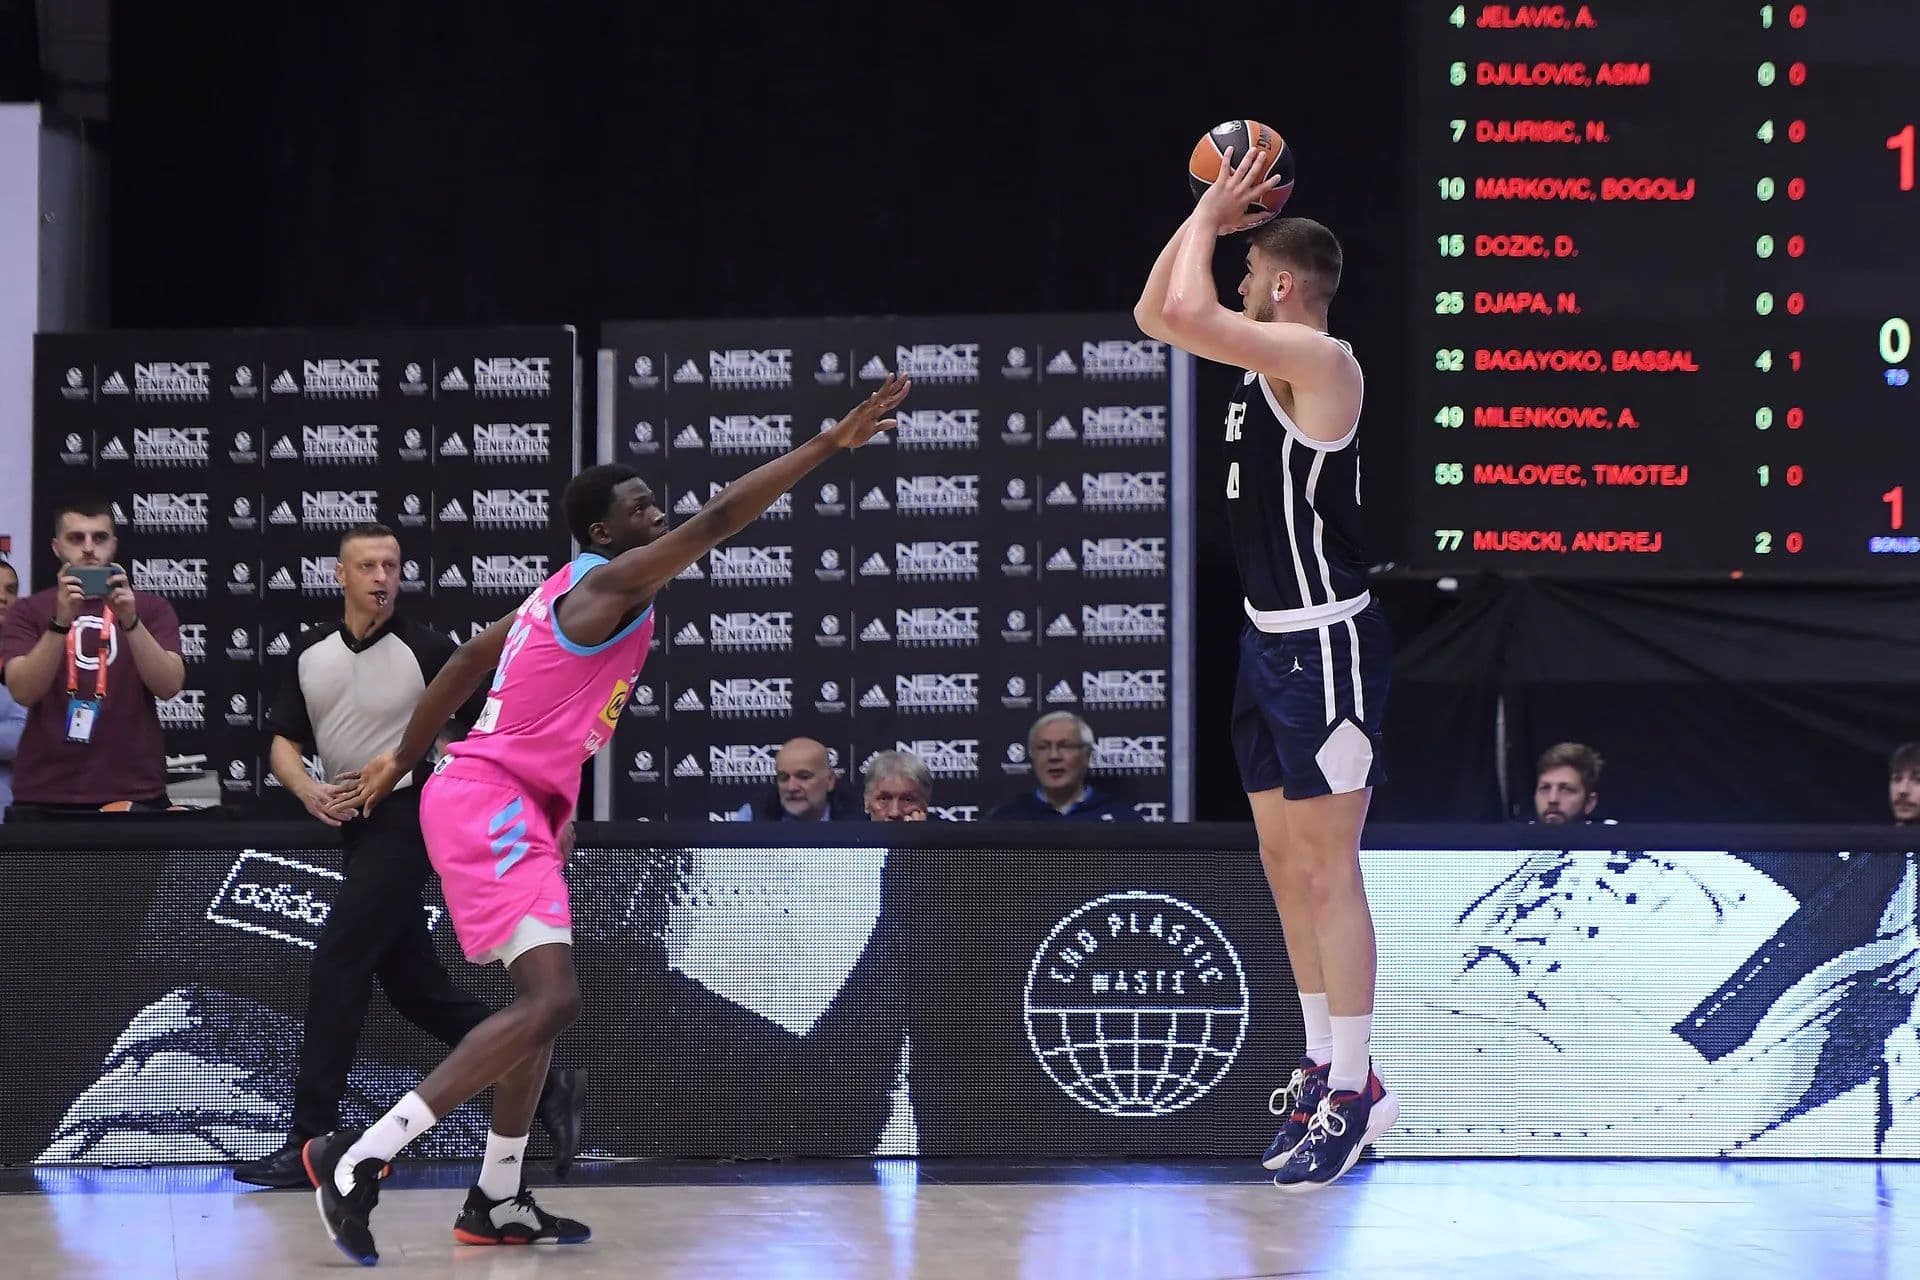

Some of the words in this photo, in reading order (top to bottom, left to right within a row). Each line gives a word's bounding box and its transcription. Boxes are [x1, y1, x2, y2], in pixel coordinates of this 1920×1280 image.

[1450, 5, 1465, 28] 4
[1575, 6, 1597, 28] A.
[1760, 5, 1772, 28] 1
[1789, 5, 1807, 28] 0
[1477, 62, 1592, 87] DJULOVIC,
[1596, 62, 1650, 85] ASIM
[1758, 62, 1775, 86] 0
[1789, 62, 1806, 85] 0
[1450, 120, 1466, 142] 7
[1586, 121, 1609, 142] N.
[1757, 120, 1773, 143] 4
[1788, 120, 1806, 143] 0
[1886, 125, 1915, 191] 1
[1438, 177, 1465, 200] 10
[1475, 177, 1596, 201] MARKOVIC,
[1757, 177, 1774, 201] 0
[1788, 178, 1805, 200] 0
[1438, 235, 1464, 257] 15
[1475, 235, 1550, 258] DOZIC,
[1555, 235, 1578, 257] D.
[1757, 235, 1773, 258] 0
[1788, 235, 1805, 257] 0
[1436, 292, 1464, 314] 25
[1475, 292, 1552, 315] DJAPA,
[1557, 292, 1580, 313] N.
[1756, 292, 1773, 315] 0
[1787, 292, 1805, 315] 0
[1082, 340, 1166, 355] NEXT
[1880, 318, 1910, 363] 0
[710, 350, 792, 365] NEXT
[896, 345, 979, 360] NEXT
[304, 359, 379, 374] NEXT
[474, 357, 550, 372] NEXT
[1436, 349, 1464, 371] 32
[1475, 349, 1607, 372] BAGAYOKO,
[1612, 350, 1699, 371] BASSAL
[1755, 350, 1772, 372] 4
[1789, 351, 1801, 371] 1
[134, 362, 210, 377] NEXT
[896, 411, 979, 426] NEXT
[1082, 405, 1166, 420] NEXT
[1474, 407, 1612, 429] MILENKOVIC,
[1617, 408, 1639, 428] A.
[1756, 407, 1772, 429] 0
[1787, 408, 1803, 429] 0
[472, 423, 550, 438] NEXT
[710, 416, 792, 431] NEXT
[134, 427, 208, 442] NEXT
[302, 425, 378, 440] NEXT
[1082, 471, 1166, 486] NEXT
[1474, 464, 1587, 486] MALOVEC,
[1592, 464, 1688, 486] TIMOTEJ
[1757, 465, 1769, 486] 1
[1787, 465, 1803, 486] 0
[896, 476, 979, 491] NEXT
[134, 493, 208, 508] NEXT
[302, 490, 377, 505] NEXT
[472, 489, 550, 504] NEXT
[1882, 486, 1903, 529] 1
[1082, 537, 1166, 552] NEXT
[1435, 530, 1464, 551] 77
[1474, 531, 1567, 552] MUSICKI,
[1572, 531, 1662, 552] ANDREJ
[1755, 532, 1771, 553] 2
[1786, 532, 1803, 553] 0
[710, 547, 792, 562] NEXT
[896, 542, 979, 557] NEXT
[132, 558, 206, 573] NEXT
[301, 557, 340, 572] NE
[472, 554, 548, 569] NEXT
[896, 608, 979, 623] NEXT
[1082, 603, 1166, 618] NEXT
[710, 613, 792, 628] NEXT
[896, 674, 979, 689] NEXT
[1082, 669, 1166, 684] NEXT
[710, 679, 792, 694] NEXT
[1092, 736, 1166, 751] EXT
[231, 883, 332, 927] adida
[1049, 928, 1099, 984] END
[1106, 912, 1224, 984] PLASTIC
[1092, 970, 1185, 995] WASTE
